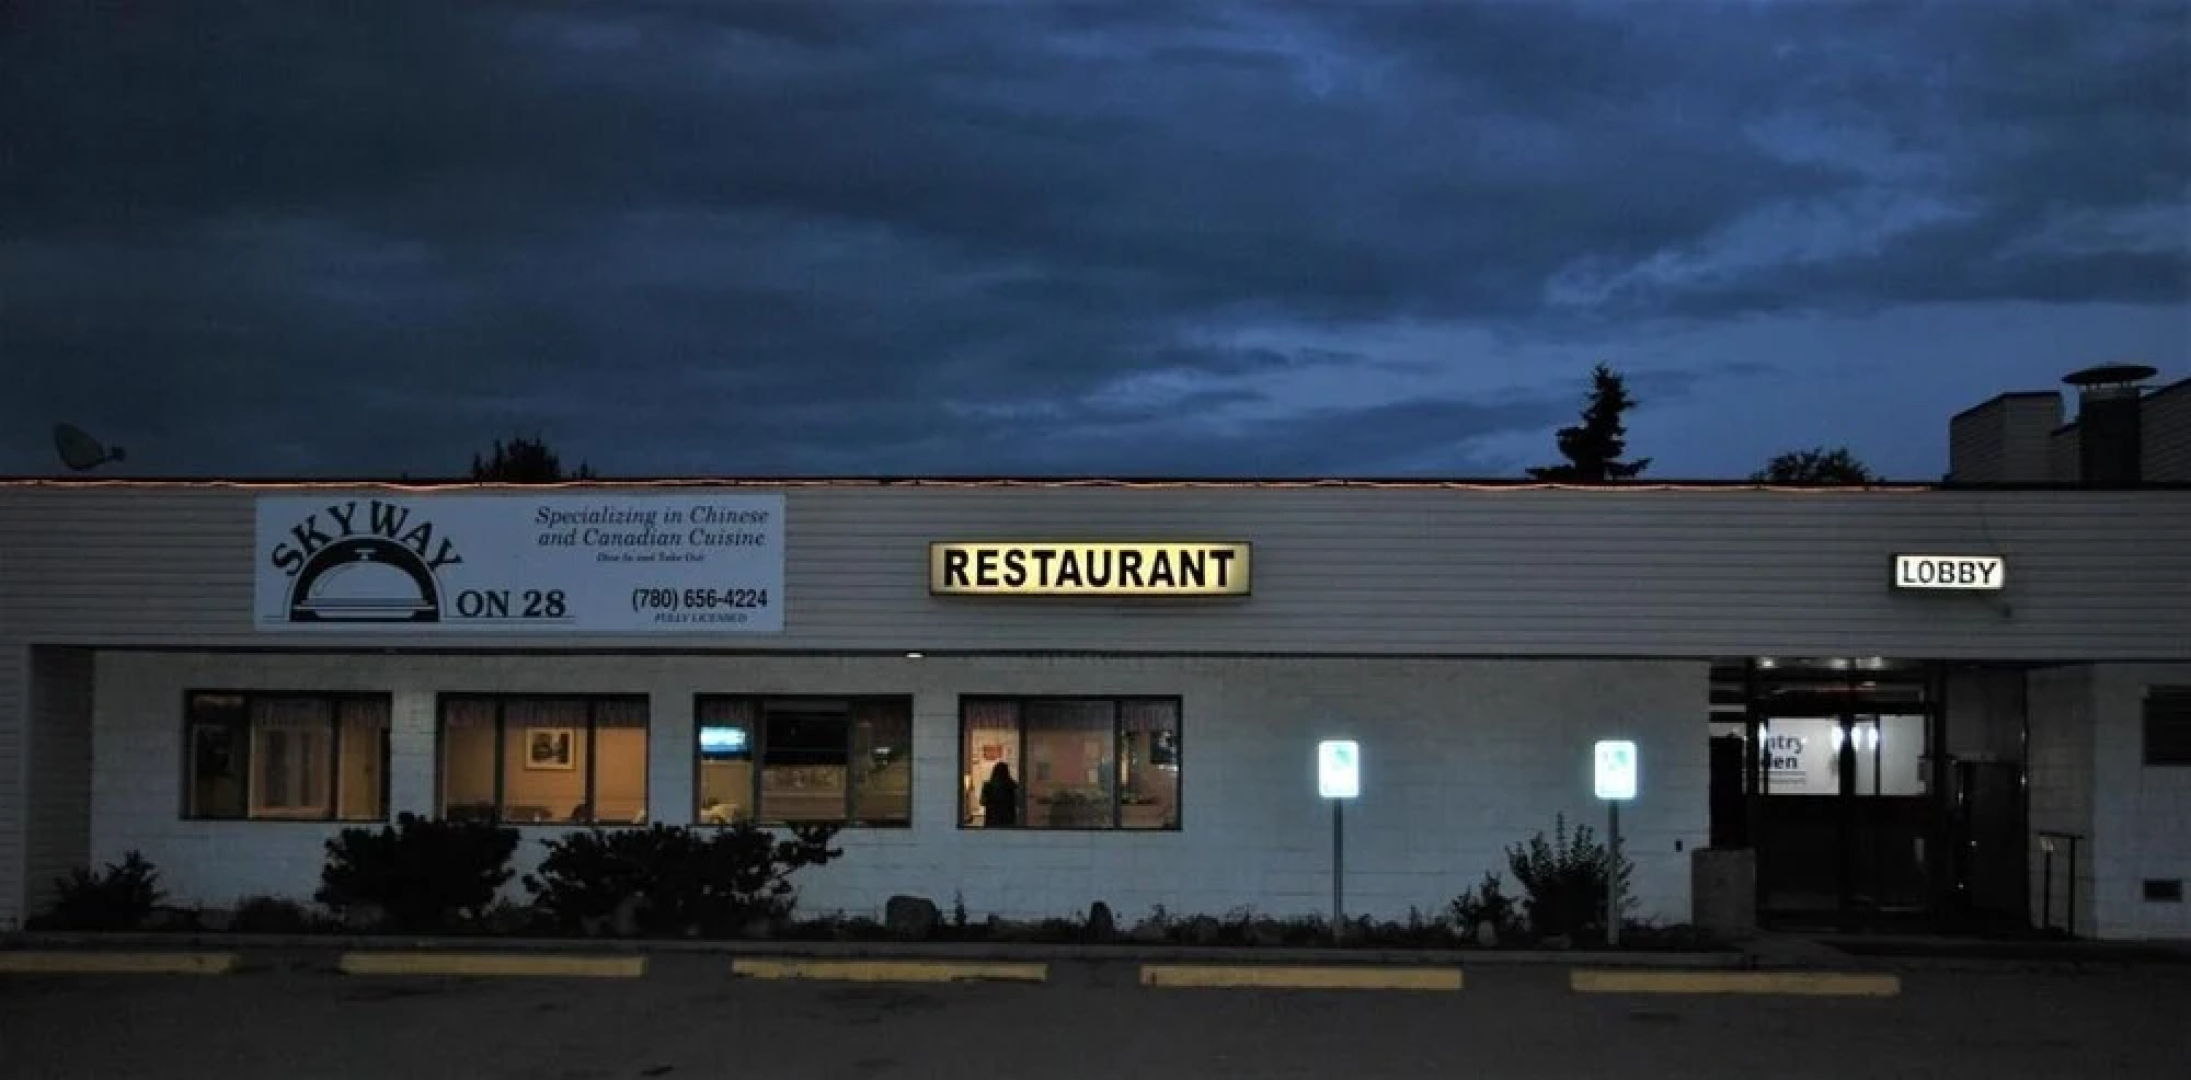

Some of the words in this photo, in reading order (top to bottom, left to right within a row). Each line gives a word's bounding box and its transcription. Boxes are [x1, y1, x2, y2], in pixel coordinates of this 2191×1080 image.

[535, 505, 658, 528] Specializing
[663, 505, 683, 524] in
[690, 505, 769, 524] Chinese
[272, 500, 463, 576] SKYWAY
[538, 528, 578, 546] and
[583, 528, 682, 546] Canadian
[689, 528, 766, 546] Cuisine
[944, 549, 1235, 587] RESTAURANT
[1903, 560, 1997, 584] LOBBY
[456, 590, 509, 617] ON
[523, 589, 566, 617] 28
[632, 588, 678, 612] (780)
[684, 588, 768, 608] 656-4224
